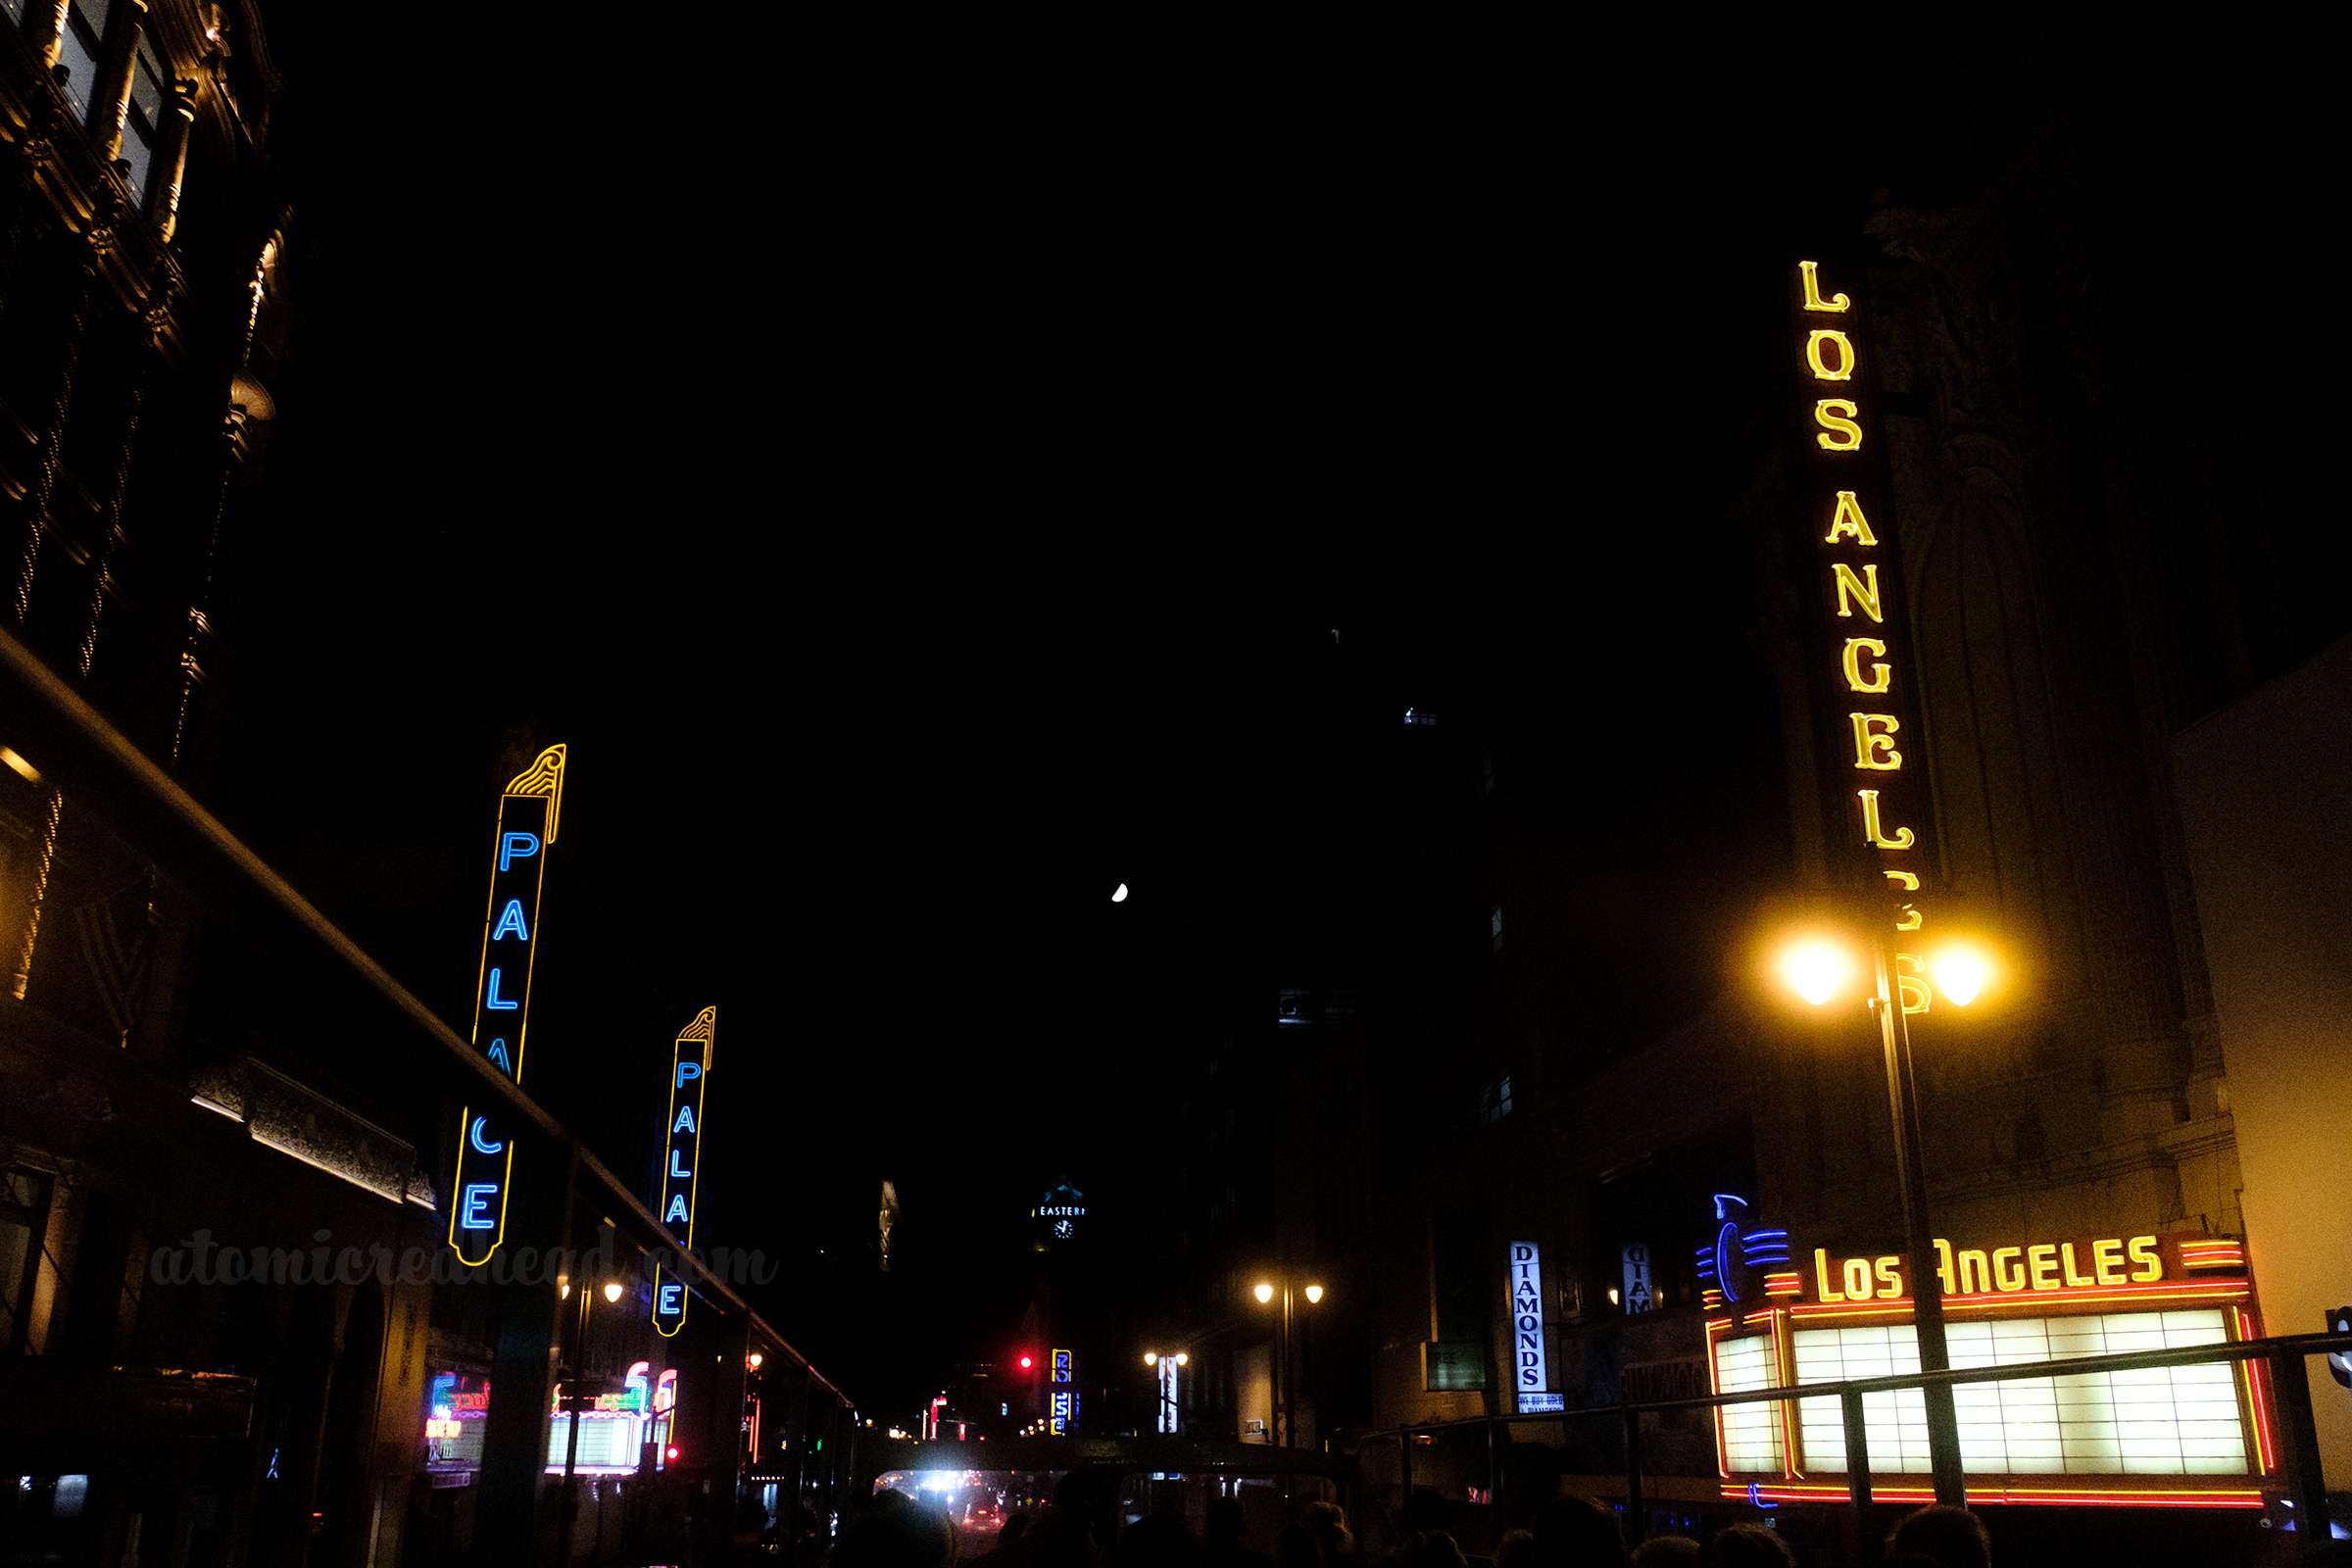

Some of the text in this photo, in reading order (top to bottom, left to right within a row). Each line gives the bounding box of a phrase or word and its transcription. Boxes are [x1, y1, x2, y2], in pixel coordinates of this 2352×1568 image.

[1798, 260, 1863, 451] LOS
[461, 831, 540, 1230] PALACE
[660, 1062, 702, 1314] PALAE
[1516, 1246, 1539, 1386] DIAMONDS
